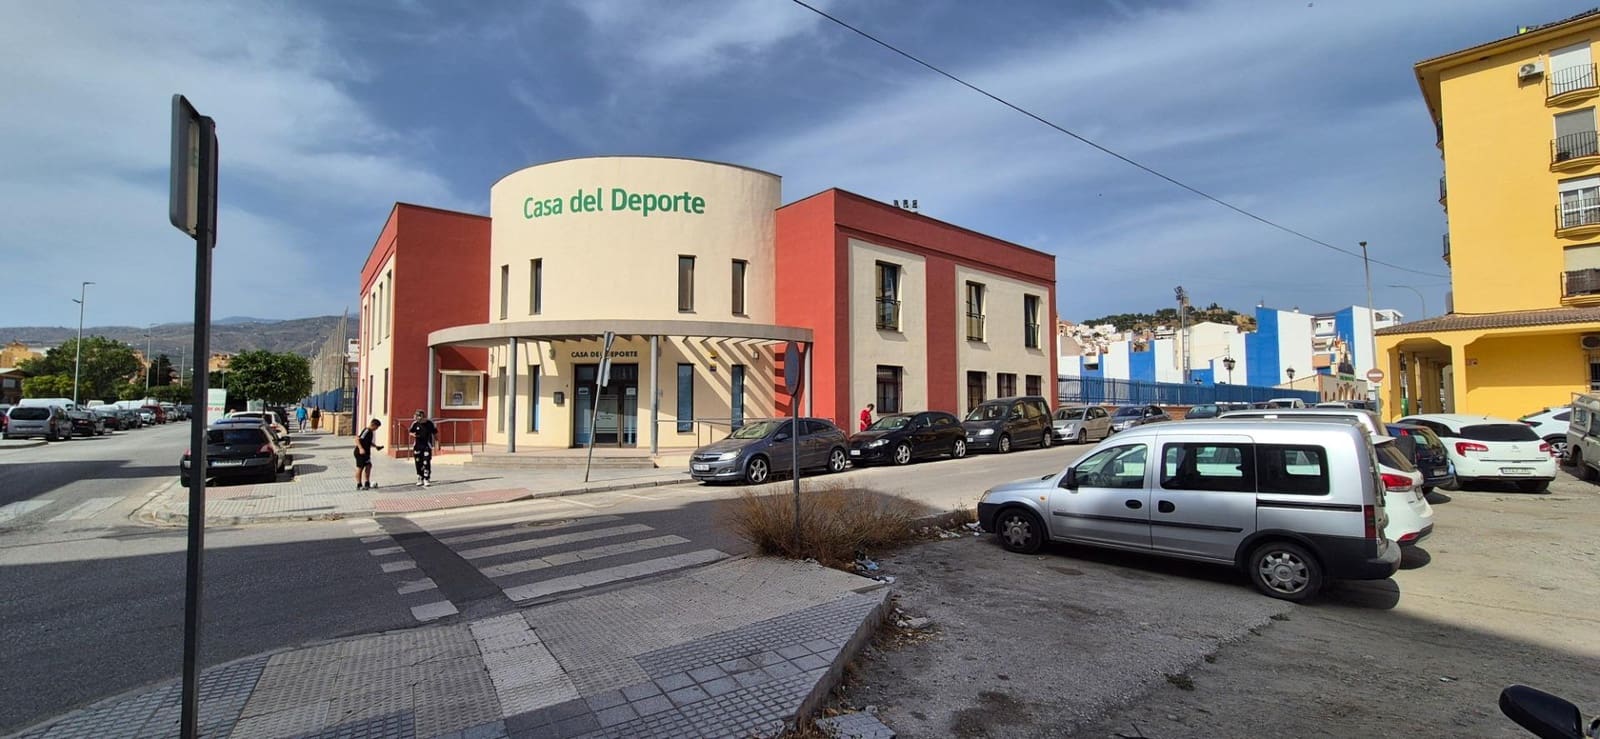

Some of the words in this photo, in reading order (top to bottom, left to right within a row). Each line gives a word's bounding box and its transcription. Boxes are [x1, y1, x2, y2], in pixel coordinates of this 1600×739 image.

[523, 197, 563, 219] Casa
[570, 187, 603, 213] del
[611, 188, 706, 217] Deporte
